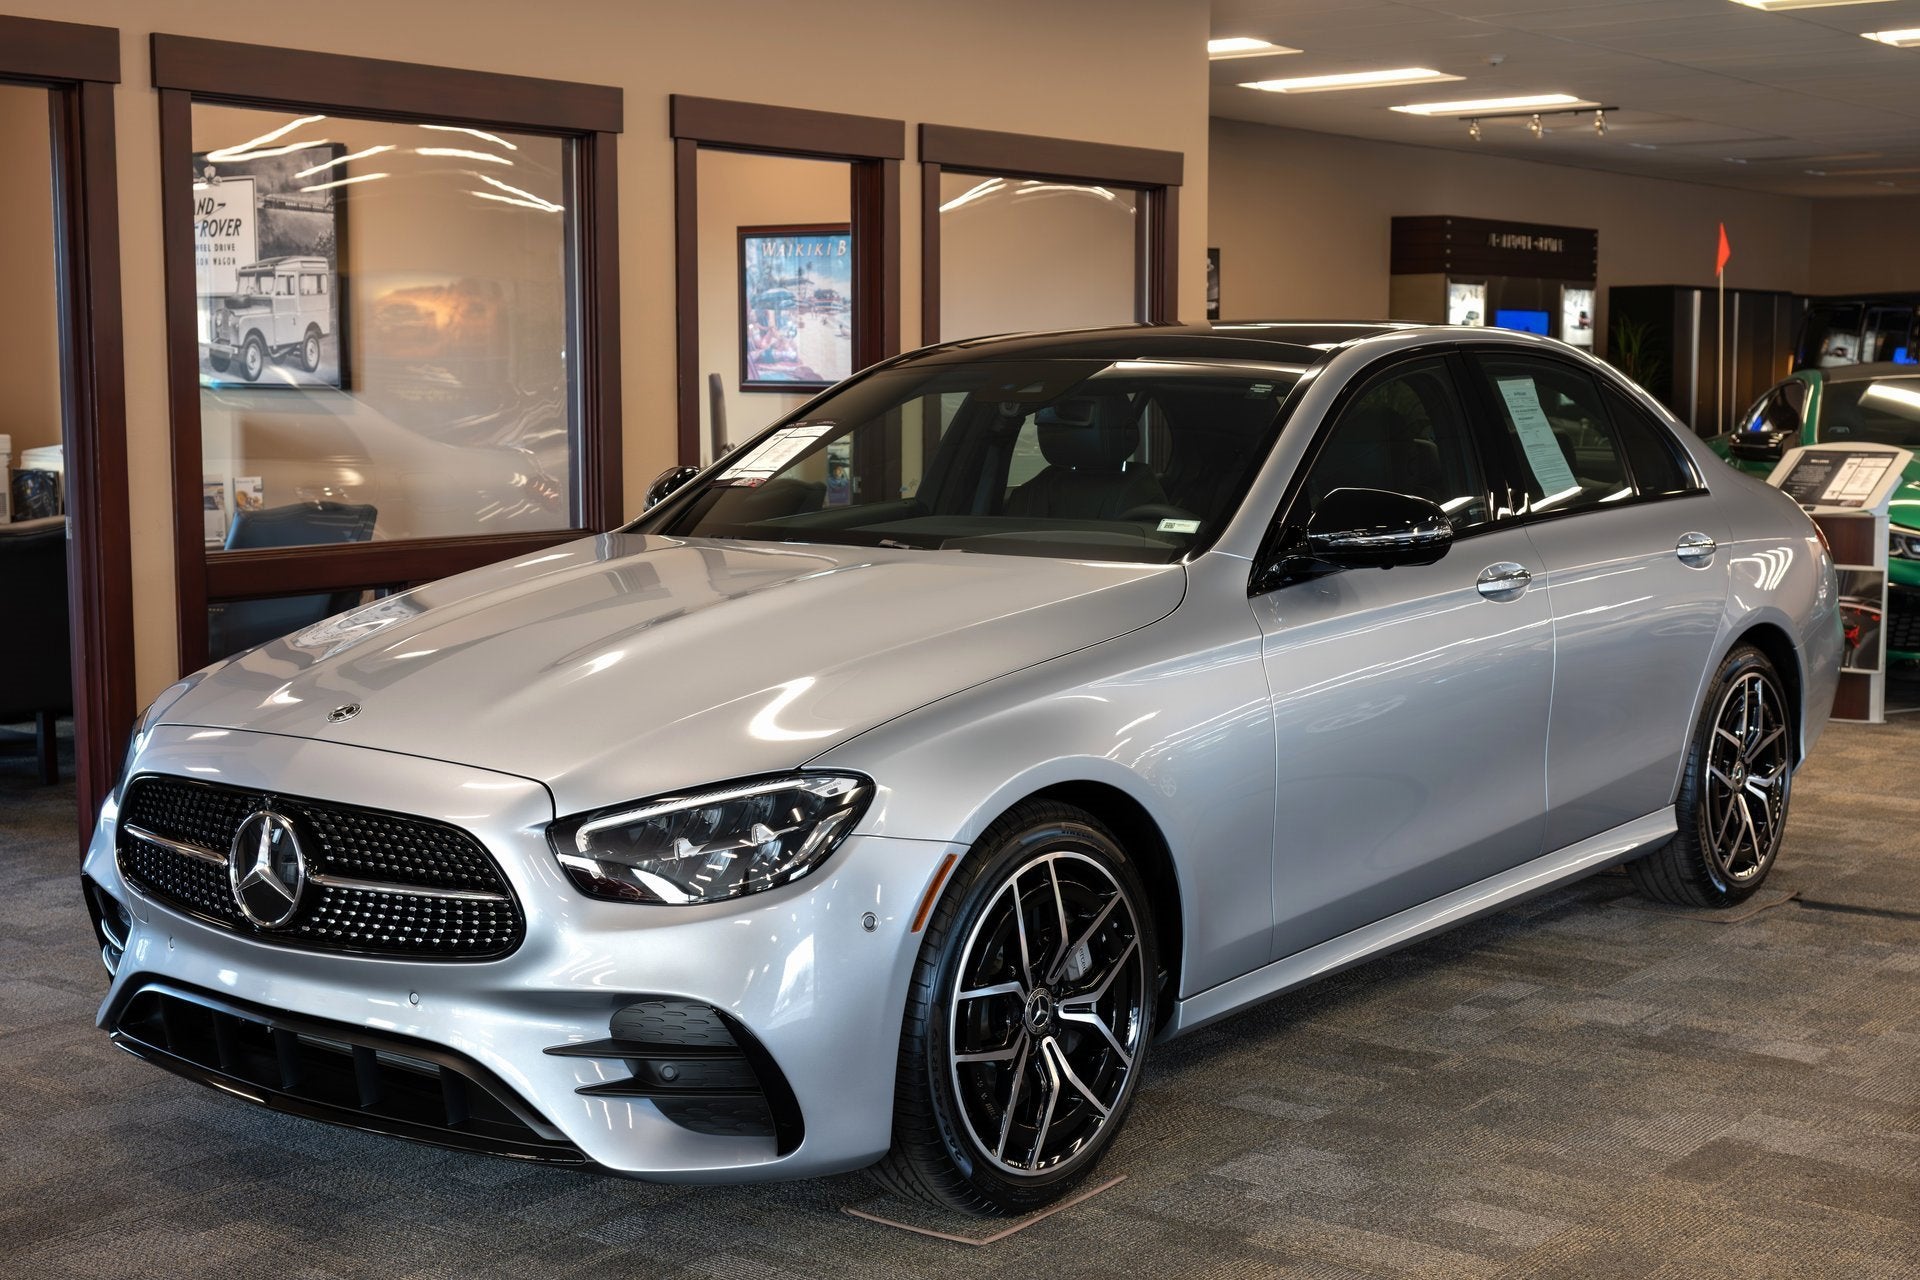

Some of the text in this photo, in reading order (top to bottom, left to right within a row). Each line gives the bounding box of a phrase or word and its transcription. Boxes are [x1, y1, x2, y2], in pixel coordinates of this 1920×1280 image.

[214, 243, 236, 252] DRIVE
[762, 240, 847, 257] WAIKIKI B
